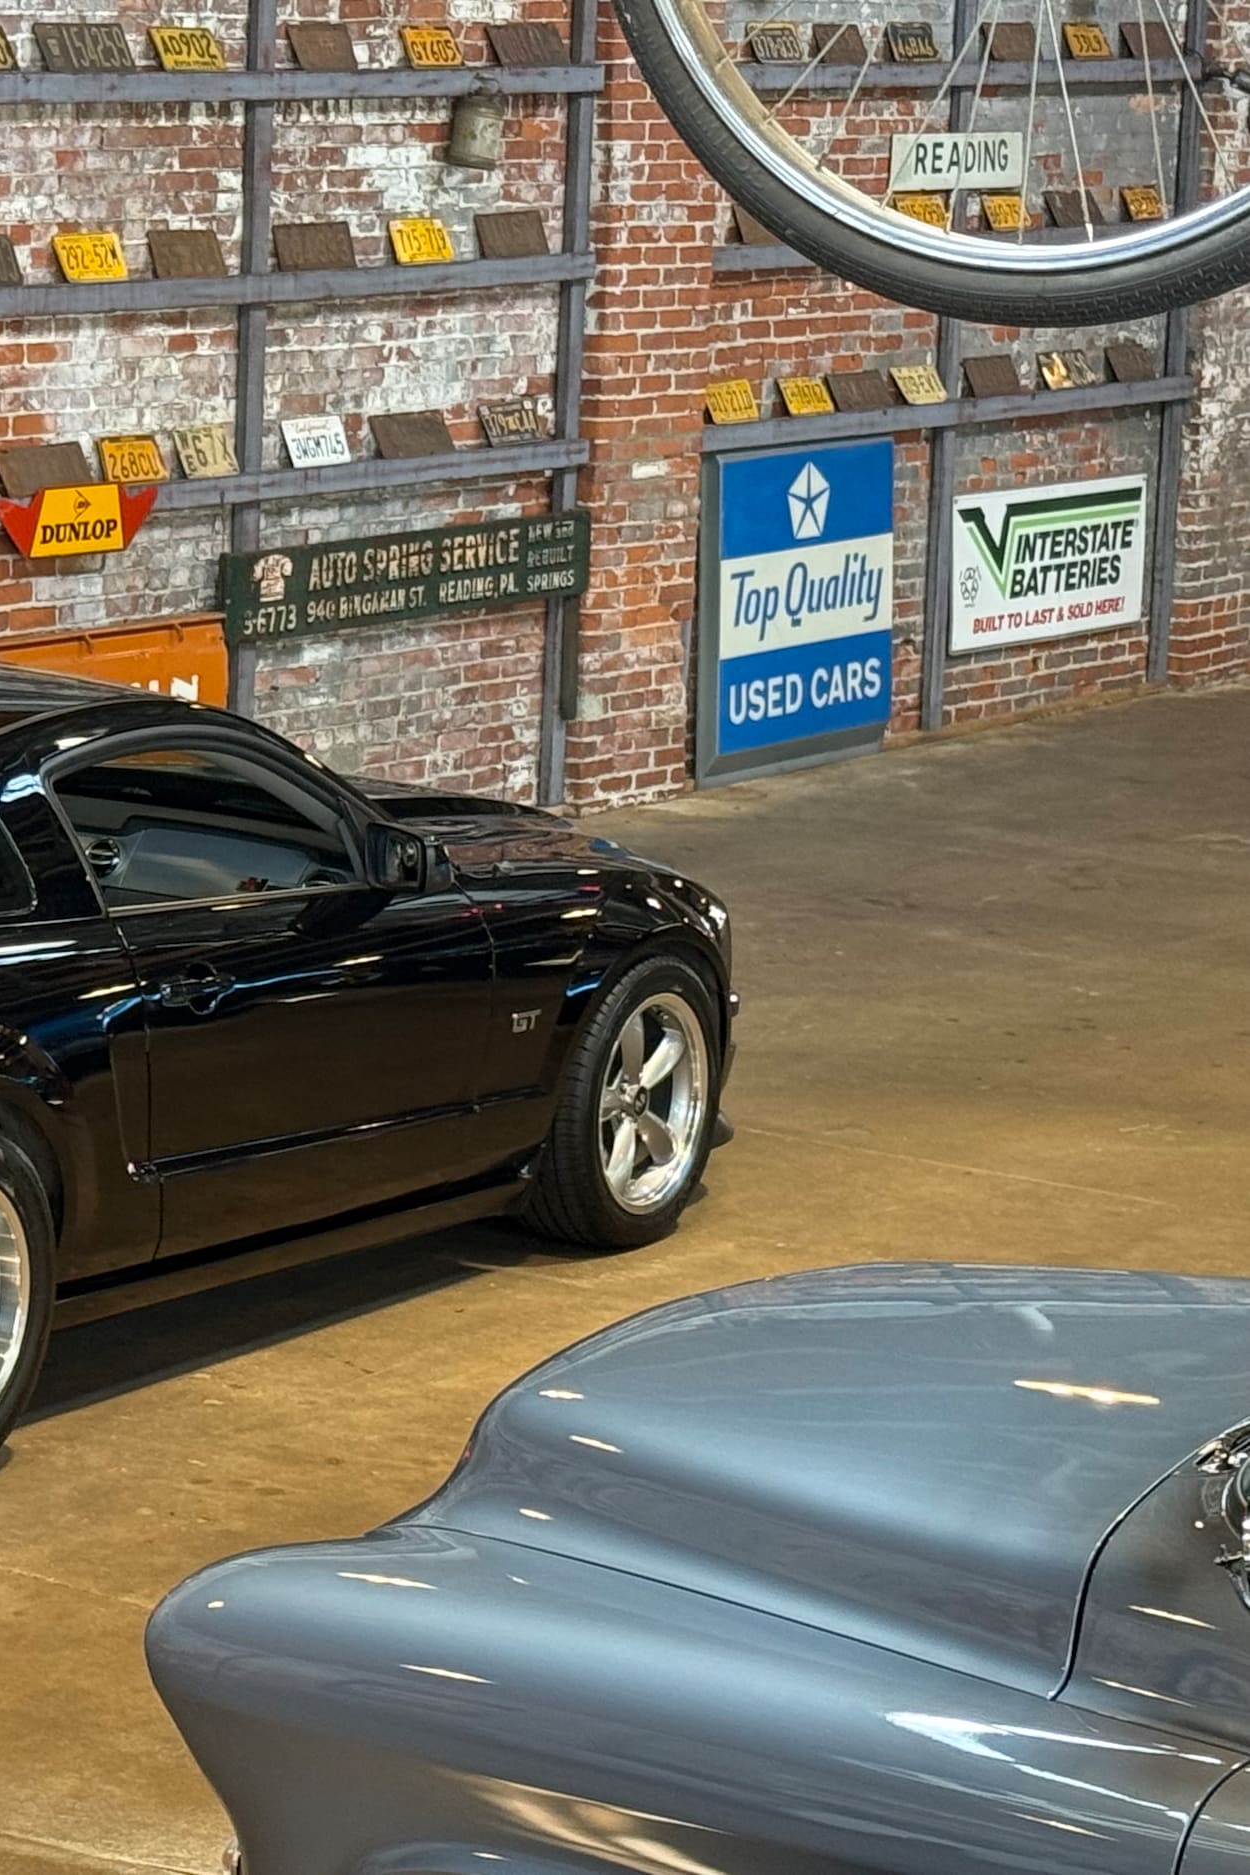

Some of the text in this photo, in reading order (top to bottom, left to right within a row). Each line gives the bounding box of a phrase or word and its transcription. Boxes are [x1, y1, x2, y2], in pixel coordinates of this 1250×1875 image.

[61, 26, 131, 69] 154259
[159, 33, 218, 58] AD902
[410, 39, 457, 62] GY605
[913, 139, 1009, 175] READING
[40, 518, 117, 545] DUNLOP
[527, 521, 553, 543] NEW
[1014, 519, 1136, 565] INTERSTATE
[308, 528, 520, 592] AUTO SPRING SERVICE
[526, 545, 575, 568] REBUILT
[408, 585, 428, 609] ST.
[526, 569, 575, 593] SPRINGS
[730, 552, 884, 641] Top Quality
[1008, 554, 1121, 600] BATTERIES
[972, 596, 1126, 635] BUILT TO LAST & SOLD HERE!
[728, 656, 882, 726] USED CARS
[511, 1008, 543, 1033] GT
